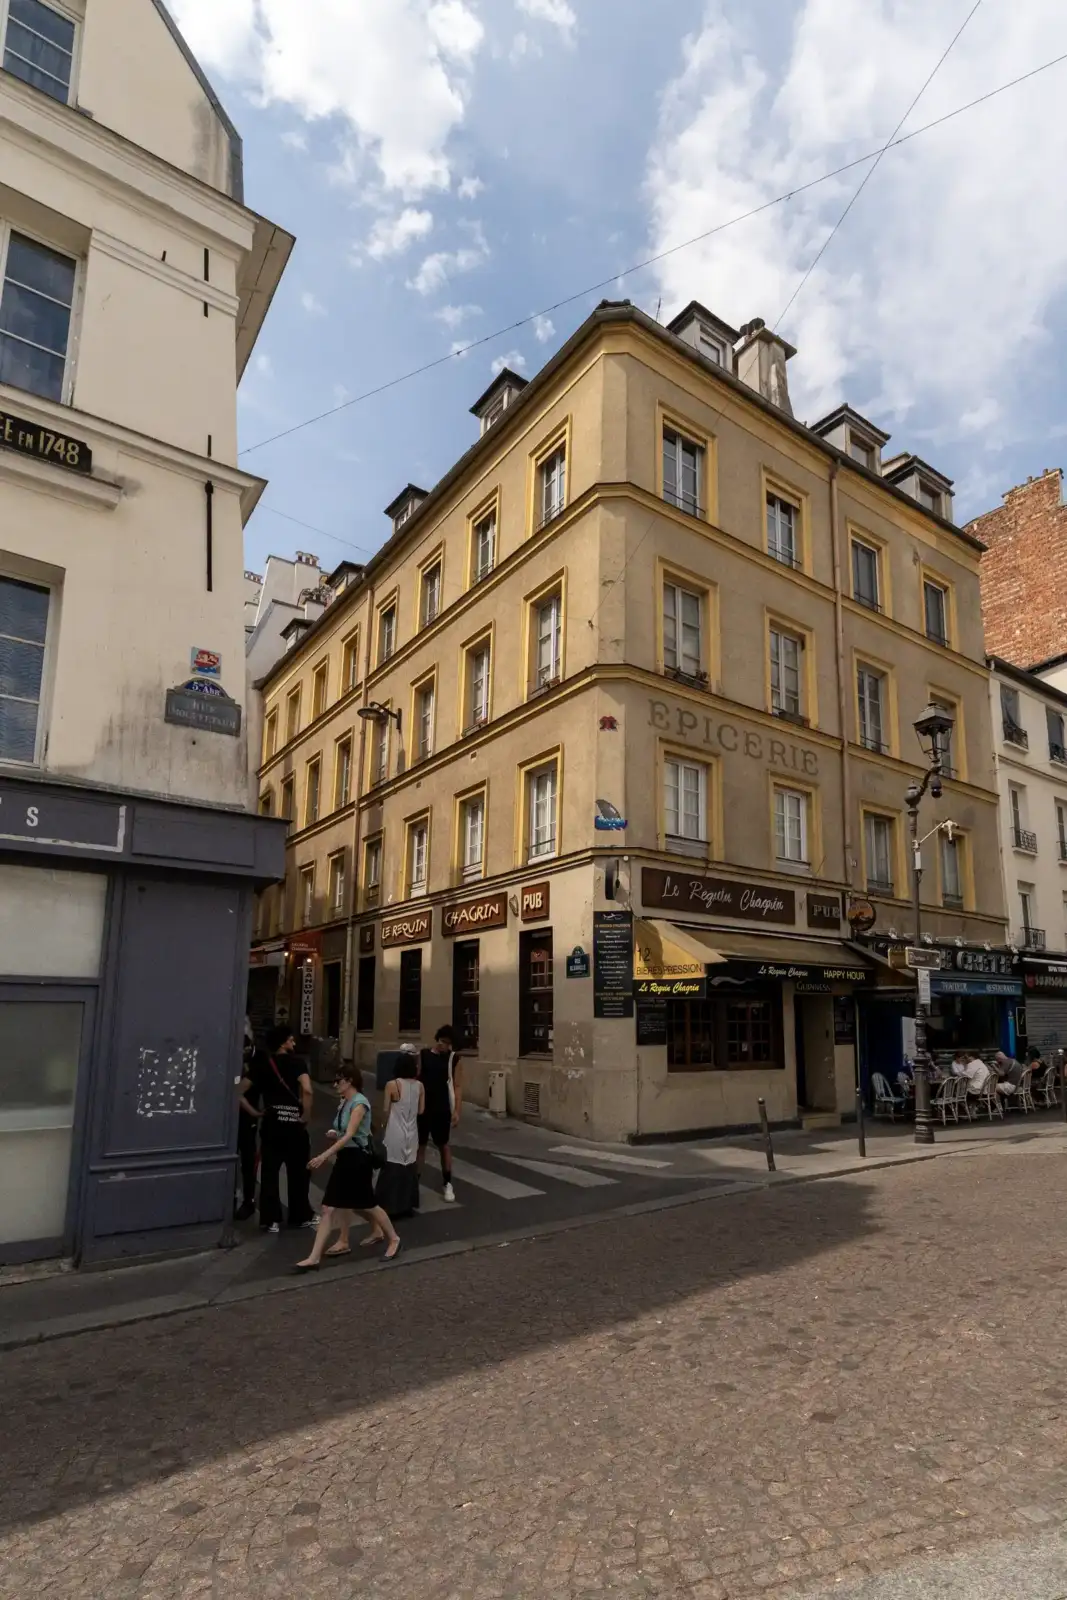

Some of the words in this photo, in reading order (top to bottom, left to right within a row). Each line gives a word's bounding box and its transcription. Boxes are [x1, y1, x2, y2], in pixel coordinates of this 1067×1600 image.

[18, 430, 34, 449] EN
[39, 430, 80, 465] 1748
[647, 699, 819, 776] EPICERIE
[26, 806, 39, 827] S
[661, 876, 680, 898] Le
[523, 892, 543, 911] PUB
[813, 904, 841, 918] PUB
[444, 903, 499, 928] CHAGRIN
[381, 928, 391, 940] LE
[392, 919, 428, 938] REQUIN
[757, 965, 767, 974] Le
[823, 969, 846, 980] HAPPY
[846, 971, 866, 981] HOUR
[638, 982, 649, 992] Le
[649, 982, 671, 995] Requin
[672, 981, 700, 994] Chagrin
